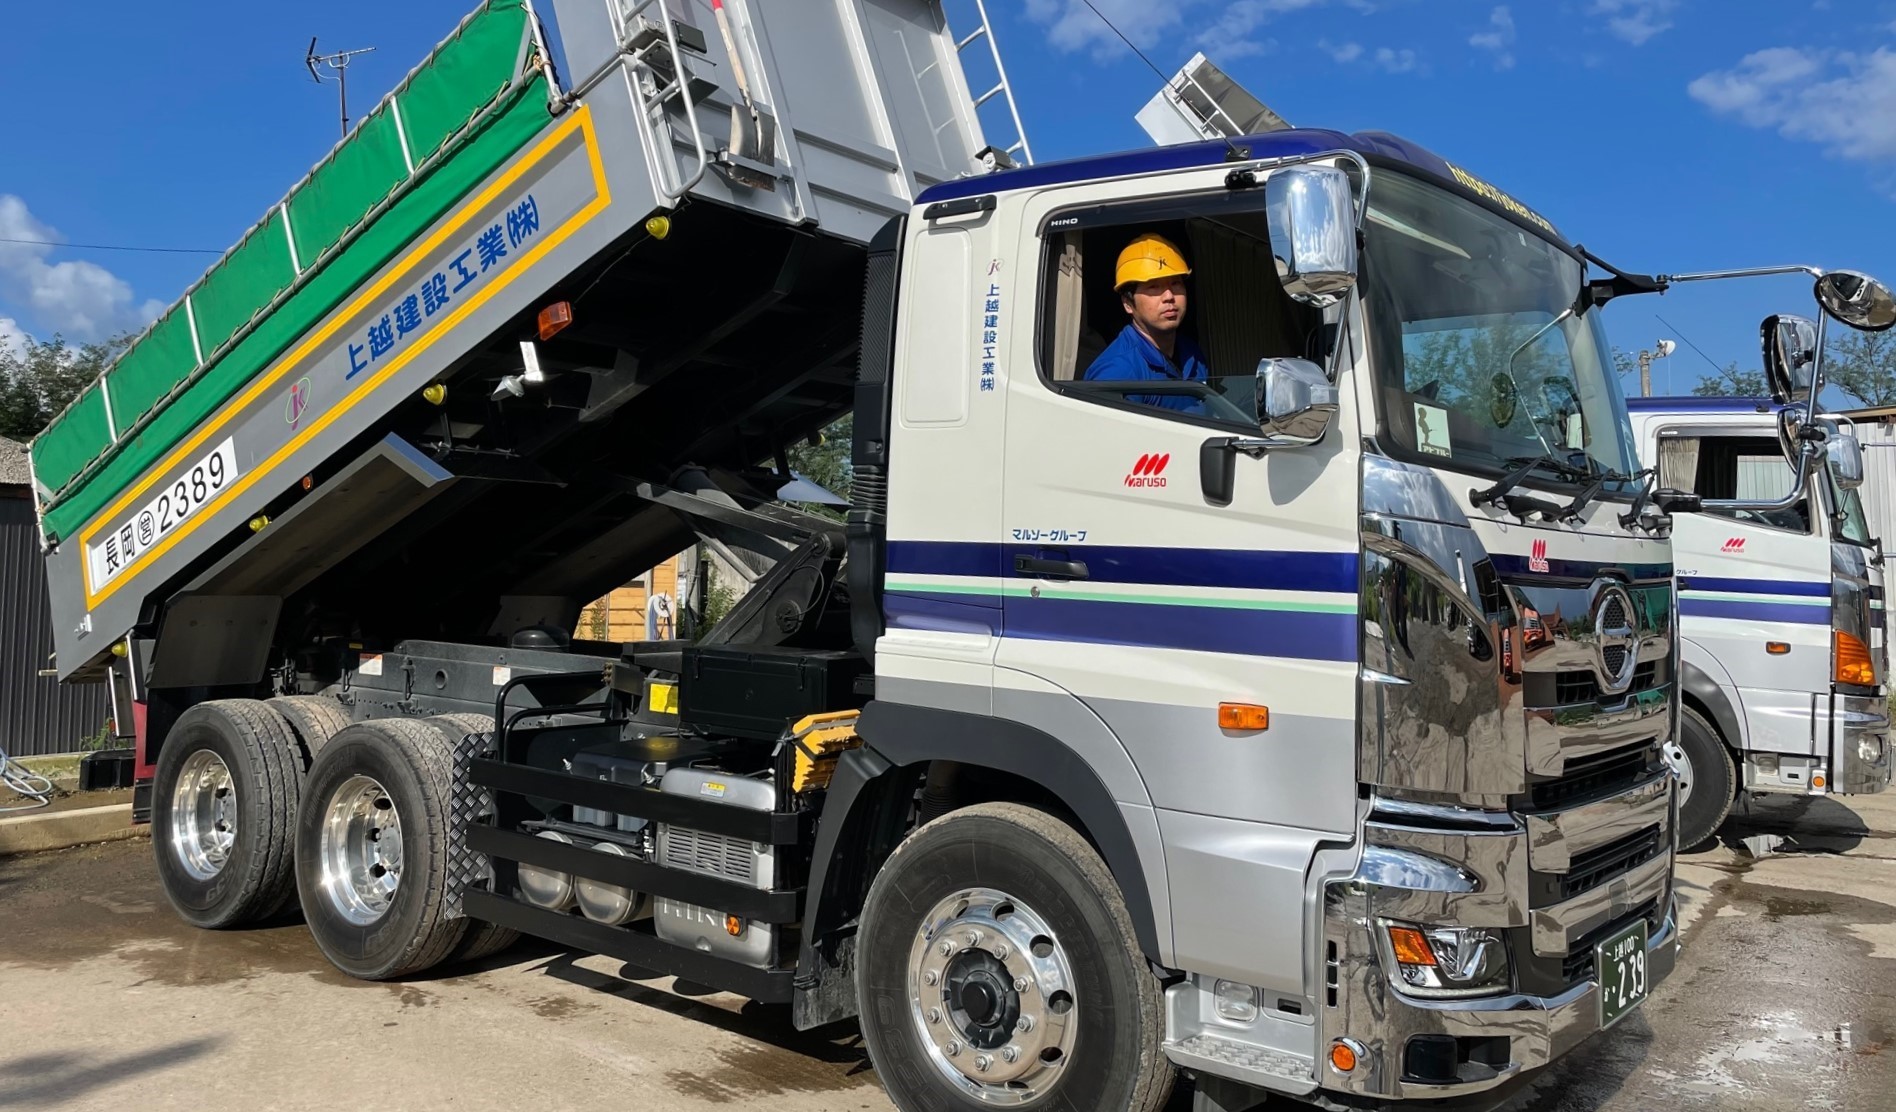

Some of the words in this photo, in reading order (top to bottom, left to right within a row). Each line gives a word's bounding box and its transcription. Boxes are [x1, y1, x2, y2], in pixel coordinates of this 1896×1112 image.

[1051, 217, 1078, 226] HINO
[345, 194, 540, 381] 上越建設工業(株)
[980, 283, 1000, 391] 上越建設工業(株)
[1012, 528, 1088, 542] マルソーグループ
